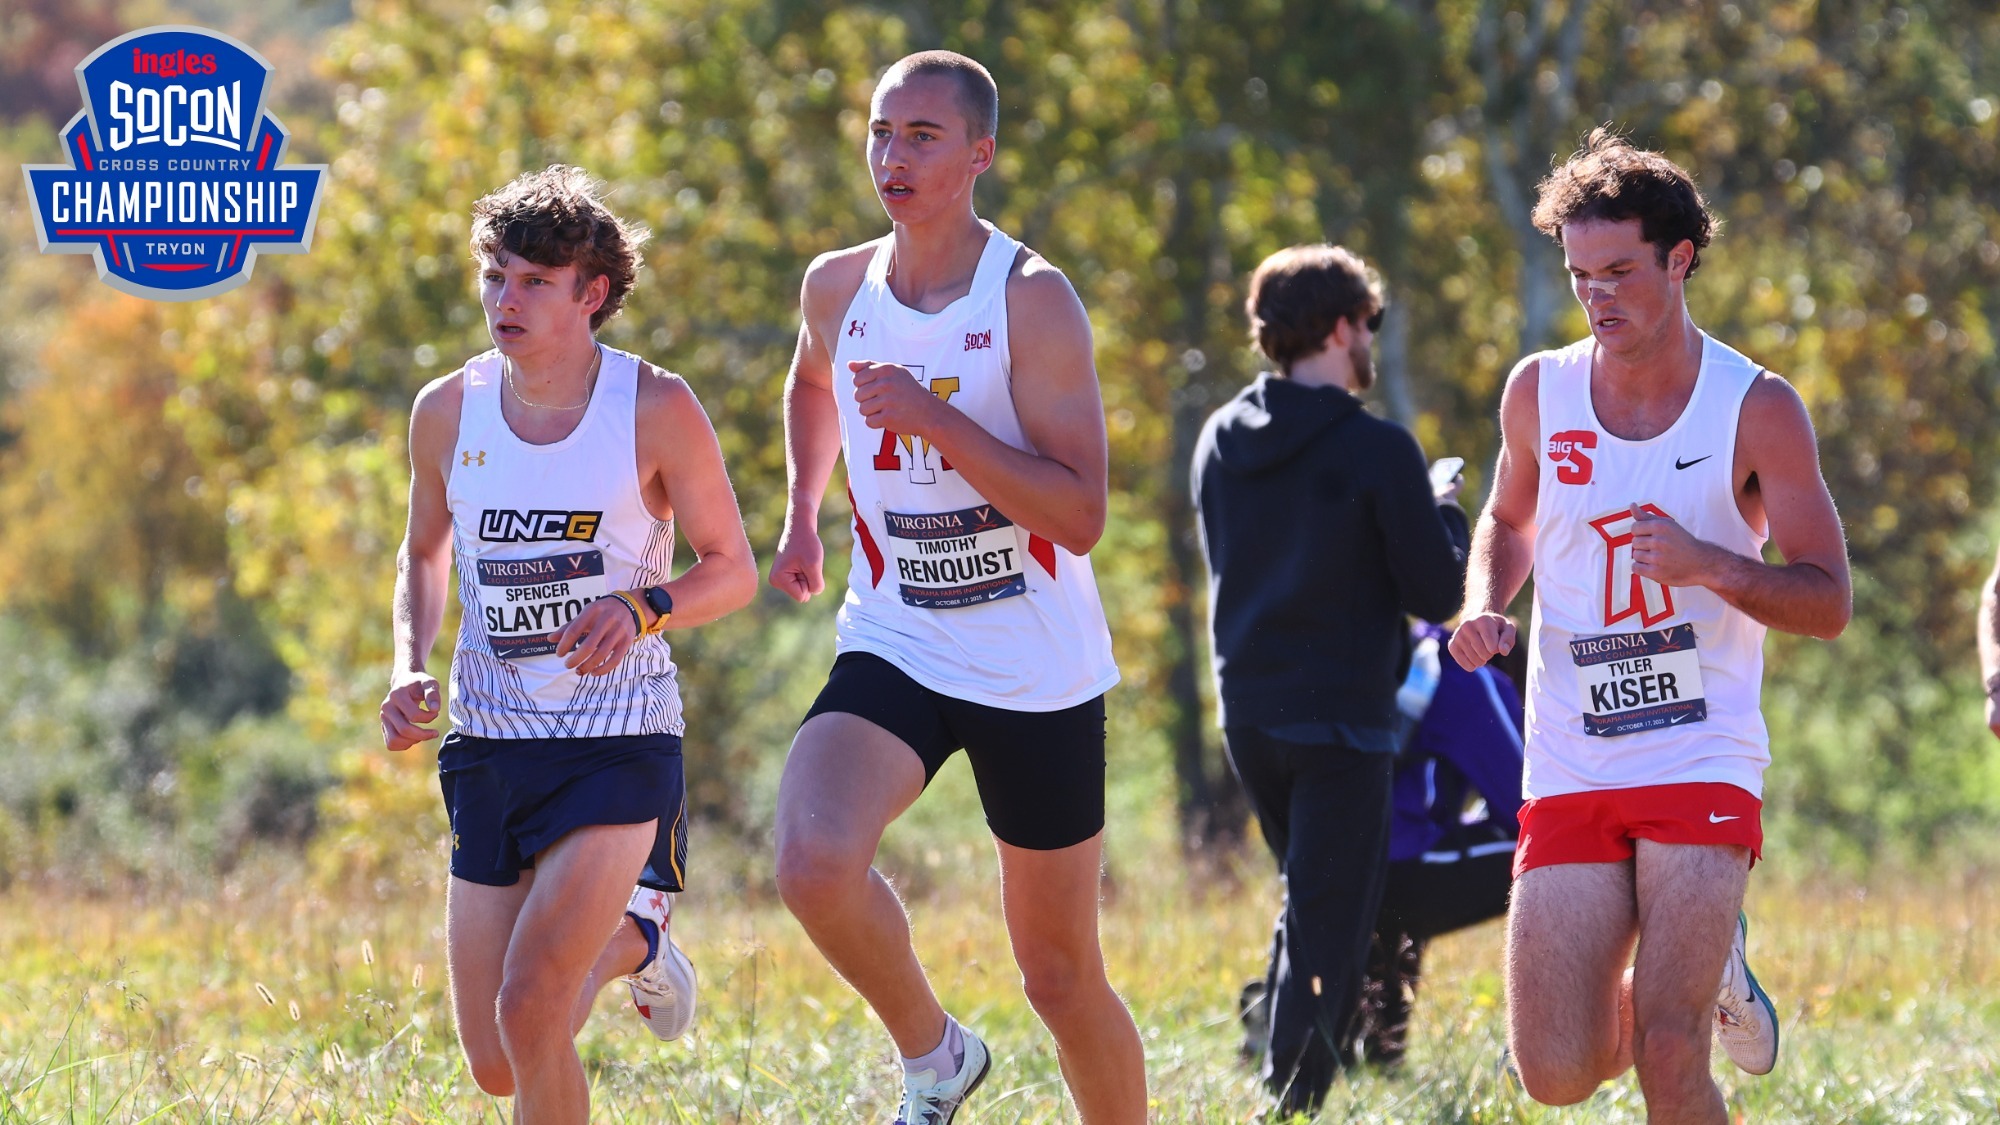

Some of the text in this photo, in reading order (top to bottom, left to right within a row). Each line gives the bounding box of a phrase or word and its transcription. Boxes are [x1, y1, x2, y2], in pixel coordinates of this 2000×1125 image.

[479, 510, 603, 542] UNCG
[892, 514, 964, 530] VIRGINIA
[896, 528, 965, 538] CROSS COUNTRY
[916, 535, 977, 555] TIMOTHY
[484, 560, 556, 576] VIRGINIA
[897, 547, 1014, 584] RENQUIST
[486, 574, 556, 585] CROSS COUNTRY
[941, 589, 962, 597] FARMS
[964, 578, 1013, 594] INVITATIONAL
[506, 583, 570, 602] SPENCER
[528, 636, 548, 644] FARM
[1570, 634, 1648, 656] VIRGINIA
[520, 646, 548, 654] OCTOBER
[1606, 647, 1649, 660] COUNTRY
[1608, 658, 1653, 677] TYLER
[1590, 672, 1679, 713] KISER
[1623, 712, 1645, 720] FARMS
[1646, 703, 1695, 717] INVITATIONAL
[1617, 722, 1644, 732] OCTOBER
